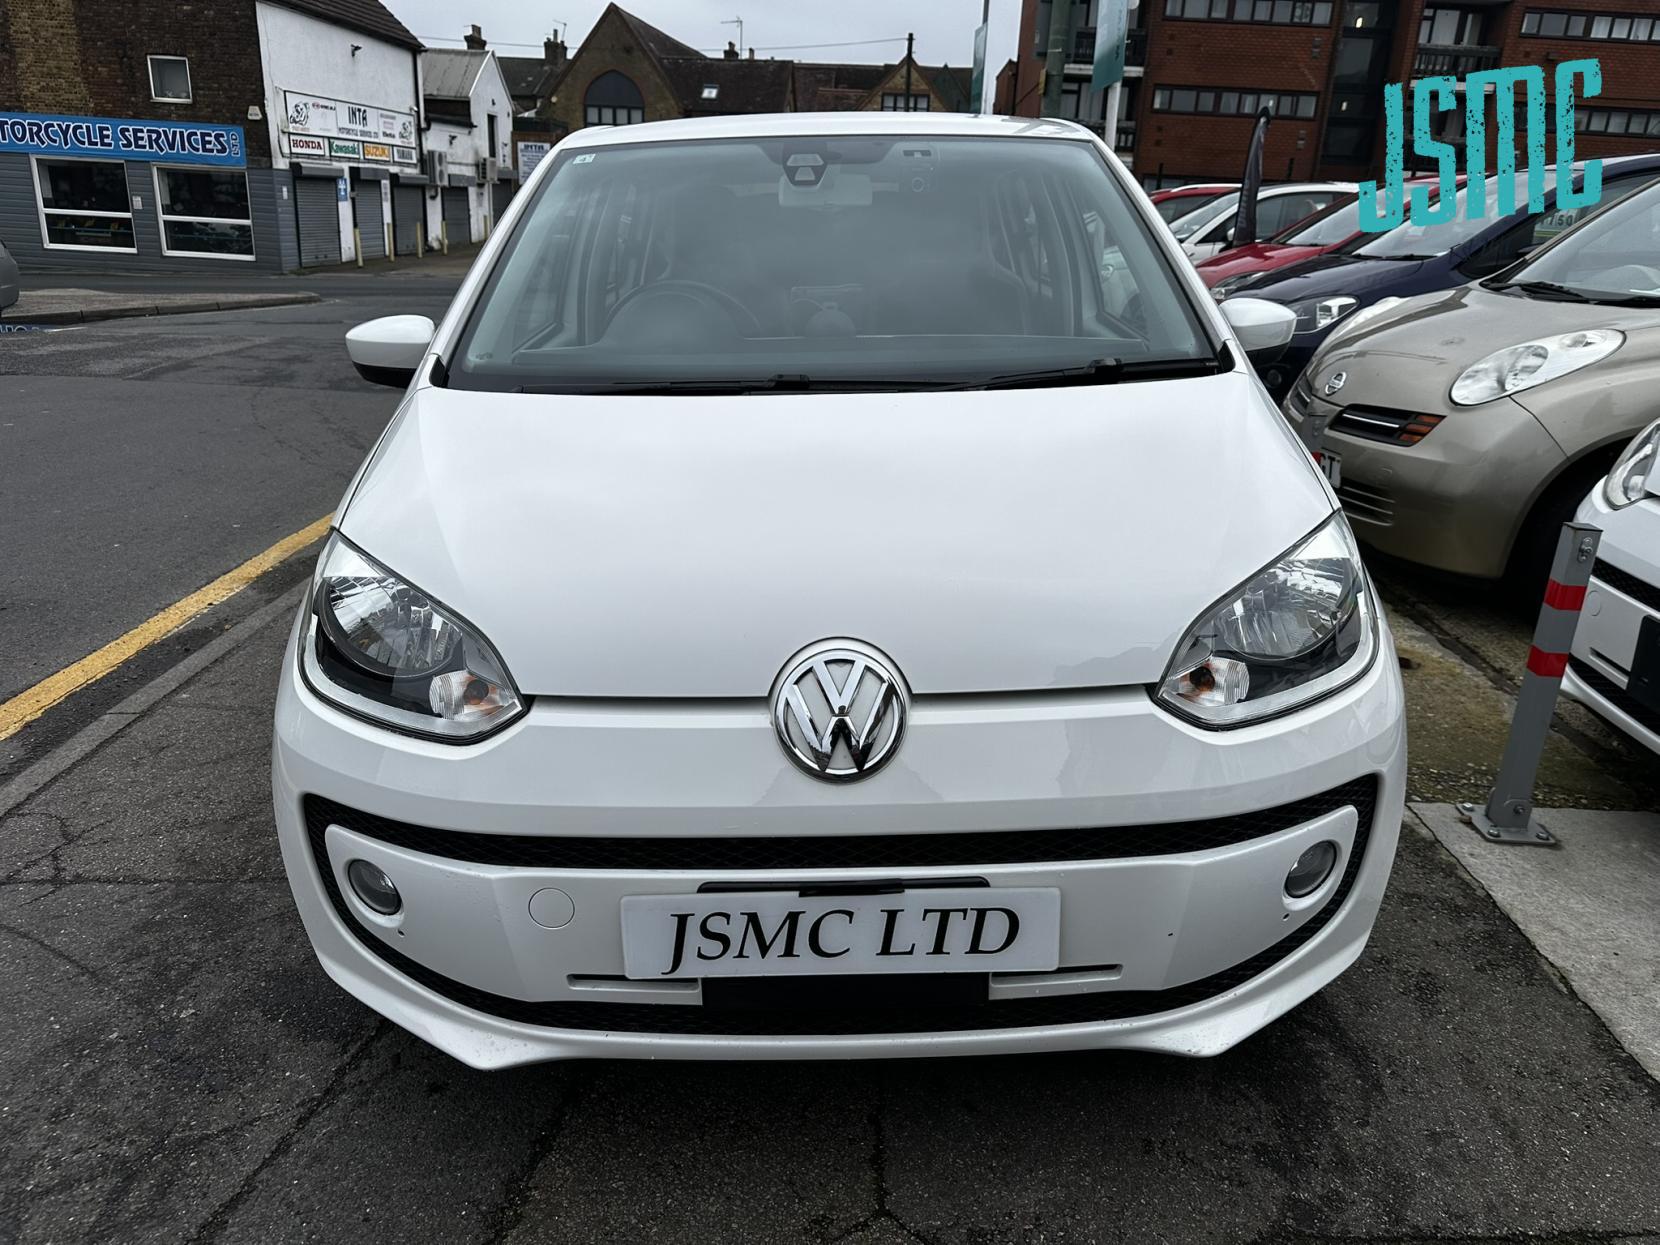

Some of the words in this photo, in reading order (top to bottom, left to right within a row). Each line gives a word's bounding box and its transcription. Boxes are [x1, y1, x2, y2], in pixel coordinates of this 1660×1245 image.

[348, 106, 368, 128] INTA
[118, 125, 230, 156] SERVICES
[230, 131, 241, 157] LTD
[292, 139, 323, 150] HONDA
[660, 908, 854, 976] JSMC
[875, 906, 1021, 957] LTD
